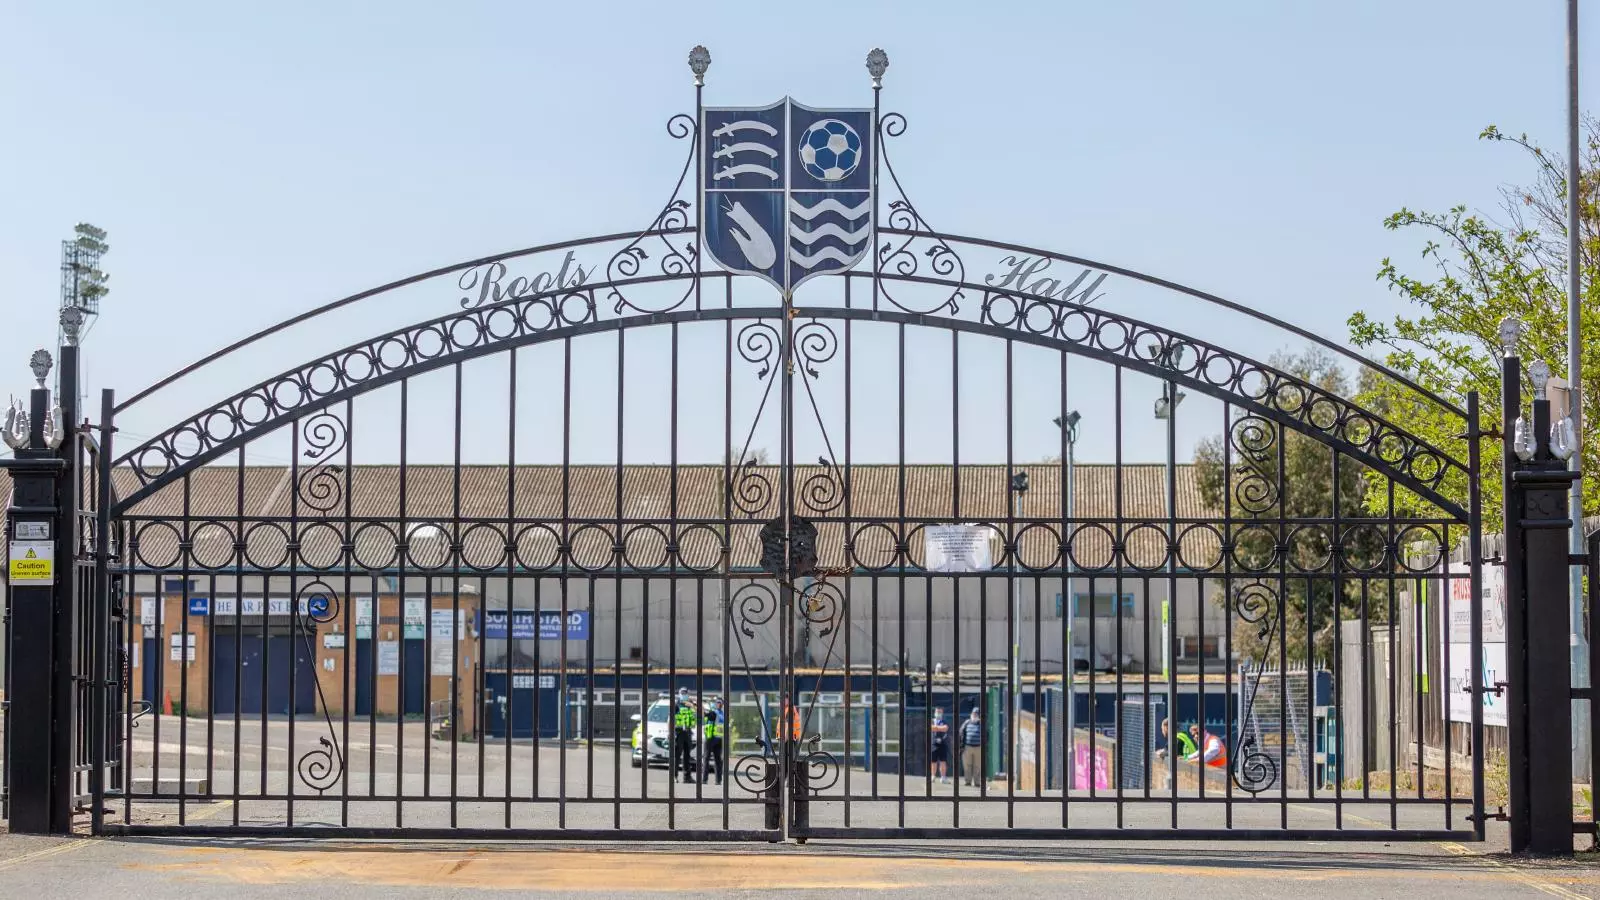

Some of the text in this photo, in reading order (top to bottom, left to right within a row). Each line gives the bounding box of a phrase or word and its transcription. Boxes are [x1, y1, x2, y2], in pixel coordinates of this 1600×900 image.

[459, 250, 1108, 309] Roots Hall
[257, 601, 282, 612] PST
[537, 613, 582, 625] STAD
